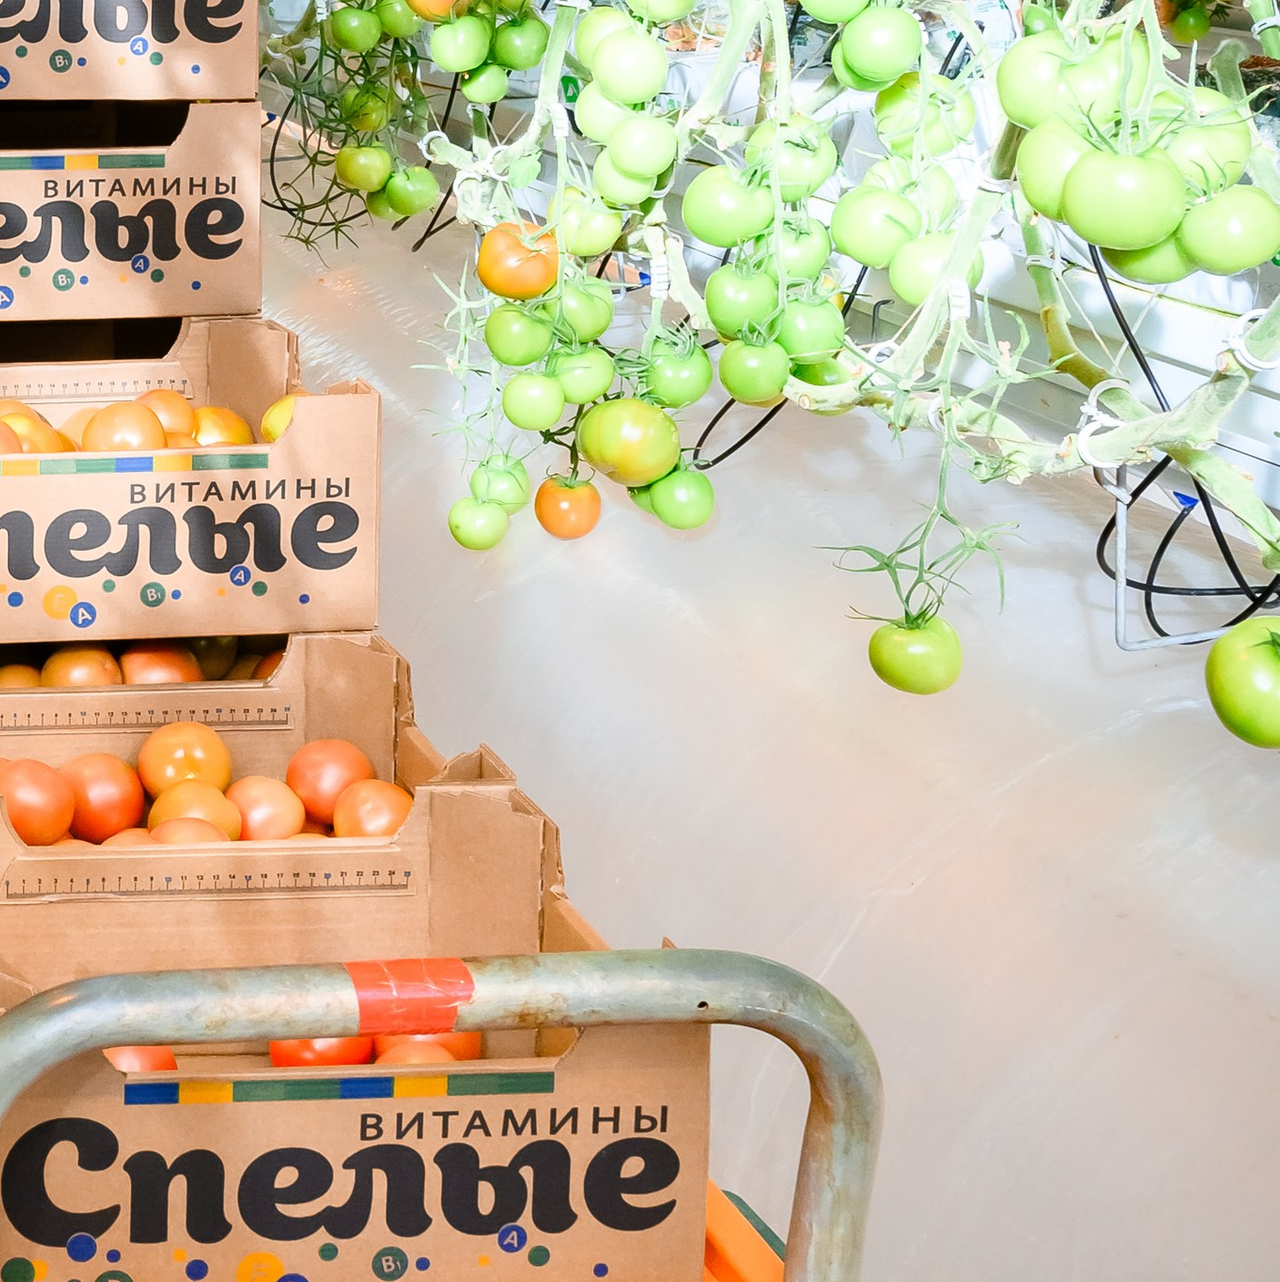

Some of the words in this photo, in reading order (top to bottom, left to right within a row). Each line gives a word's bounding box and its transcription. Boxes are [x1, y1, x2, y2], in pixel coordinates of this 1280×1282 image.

[44, 176, 237, 198] ВИТАМИНЫ
[130, 477, 350, 505] ВИТАМИНЫ
[361, 1105, 668, 1142] ВИТАМИНЫ
[0, 1116, 681, 1249] Спелые
